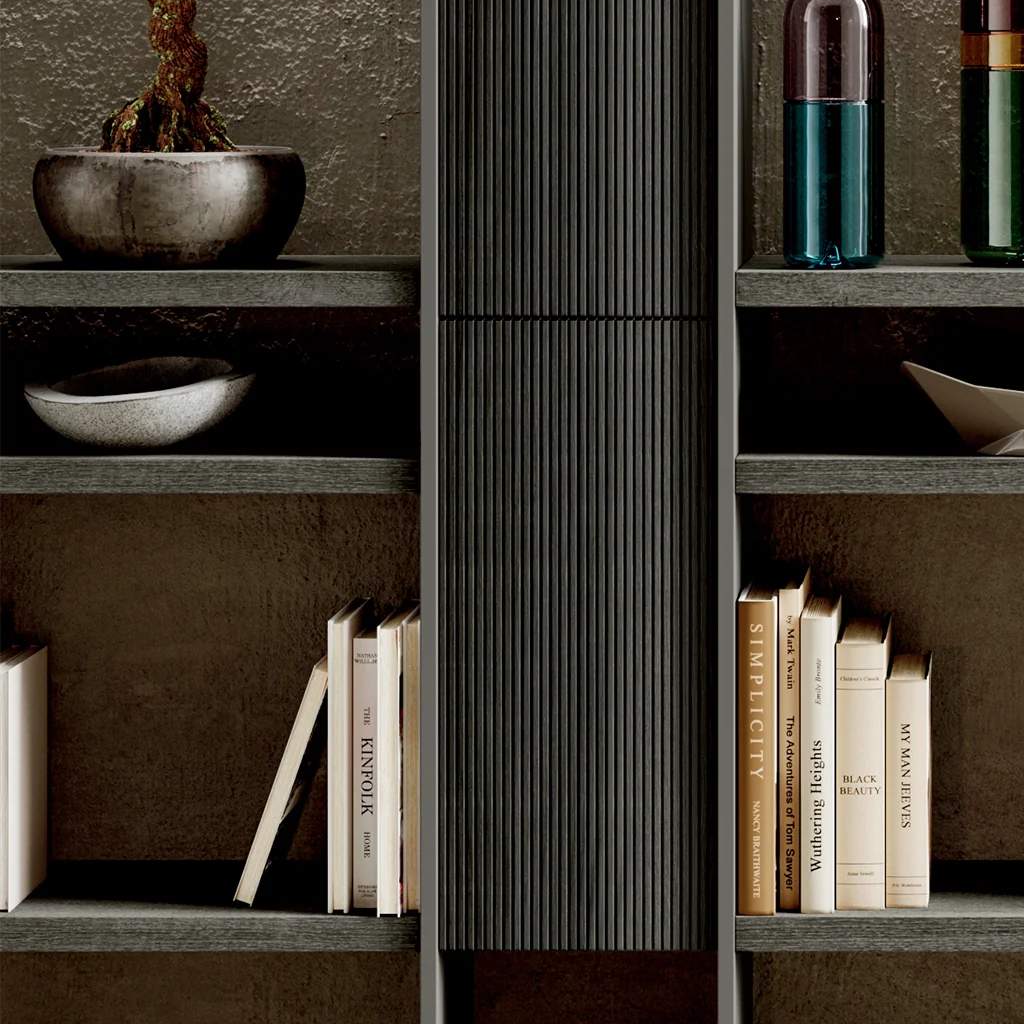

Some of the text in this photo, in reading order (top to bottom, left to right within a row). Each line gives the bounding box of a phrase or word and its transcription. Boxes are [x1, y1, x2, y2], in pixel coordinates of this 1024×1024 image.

[787, 616, 795, 690] by Mark Twain
[750, 623, 764, 778] SIMPLICITY
[815, 684, 823, 704] Emily
[361, 737, 374, 815] KINFOLK
[784, 716, 794, 890] The Adventures of Tom Sawyer
[810, 740, 825, 872] Wuthering Heights
[840, 787, 881, 795] BEAUTY
[843, 775, 877, 783] BLACK
[901, 723, 910, 828] MY MAN JEEVES
